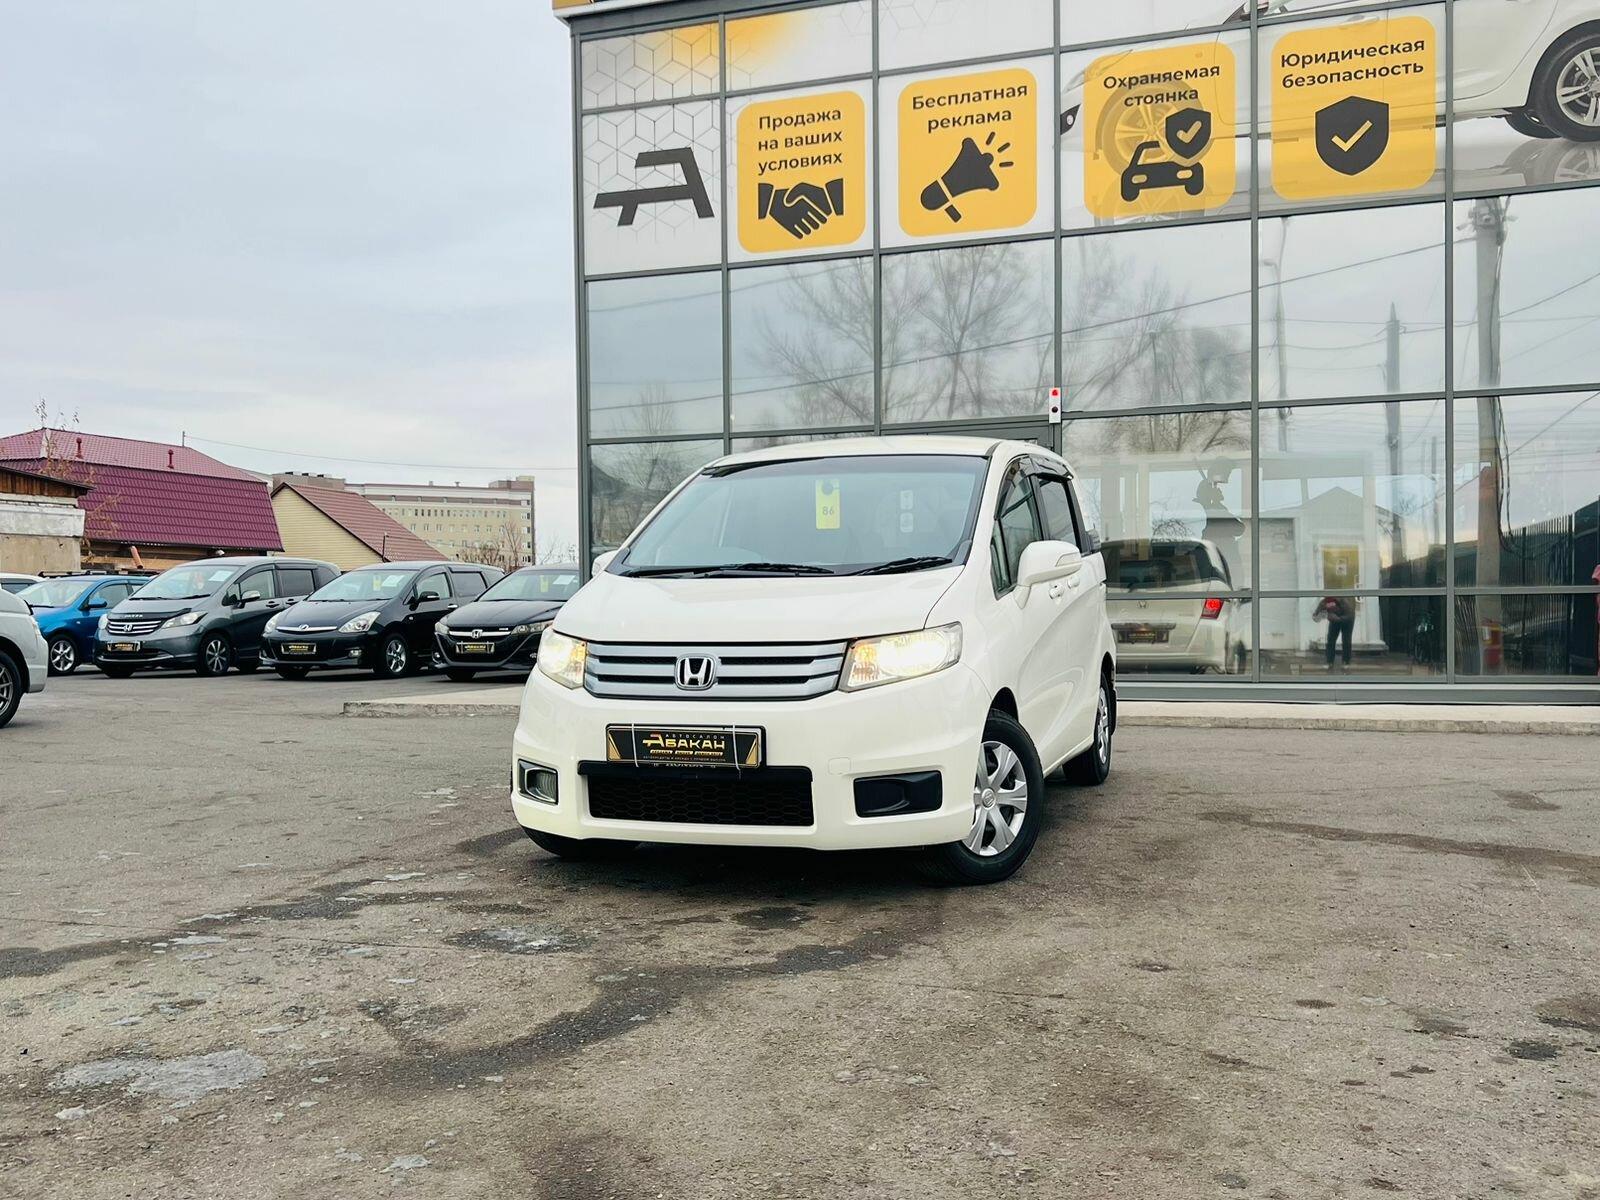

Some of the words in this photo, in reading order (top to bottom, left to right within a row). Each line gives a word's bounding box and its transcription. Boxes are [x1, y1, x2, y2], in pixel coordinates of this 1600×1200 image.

[1281, 40, 1425, 69] Юридическая
[1104, 65, 1220, 91] Охраняемая
[1282, 63, 1424, 89] безопасность
[912, 85, 1027, 110] Бесплатная
[1124, 89, 1199, 107] стоянка
[760, 110, 841, 131] Продажа
[928, 110, 1012, 134] реклама
[758, 139, 779, 151] на
[785, 131, 842, 148] ваших
[758, 152, 842, 176] условиях
